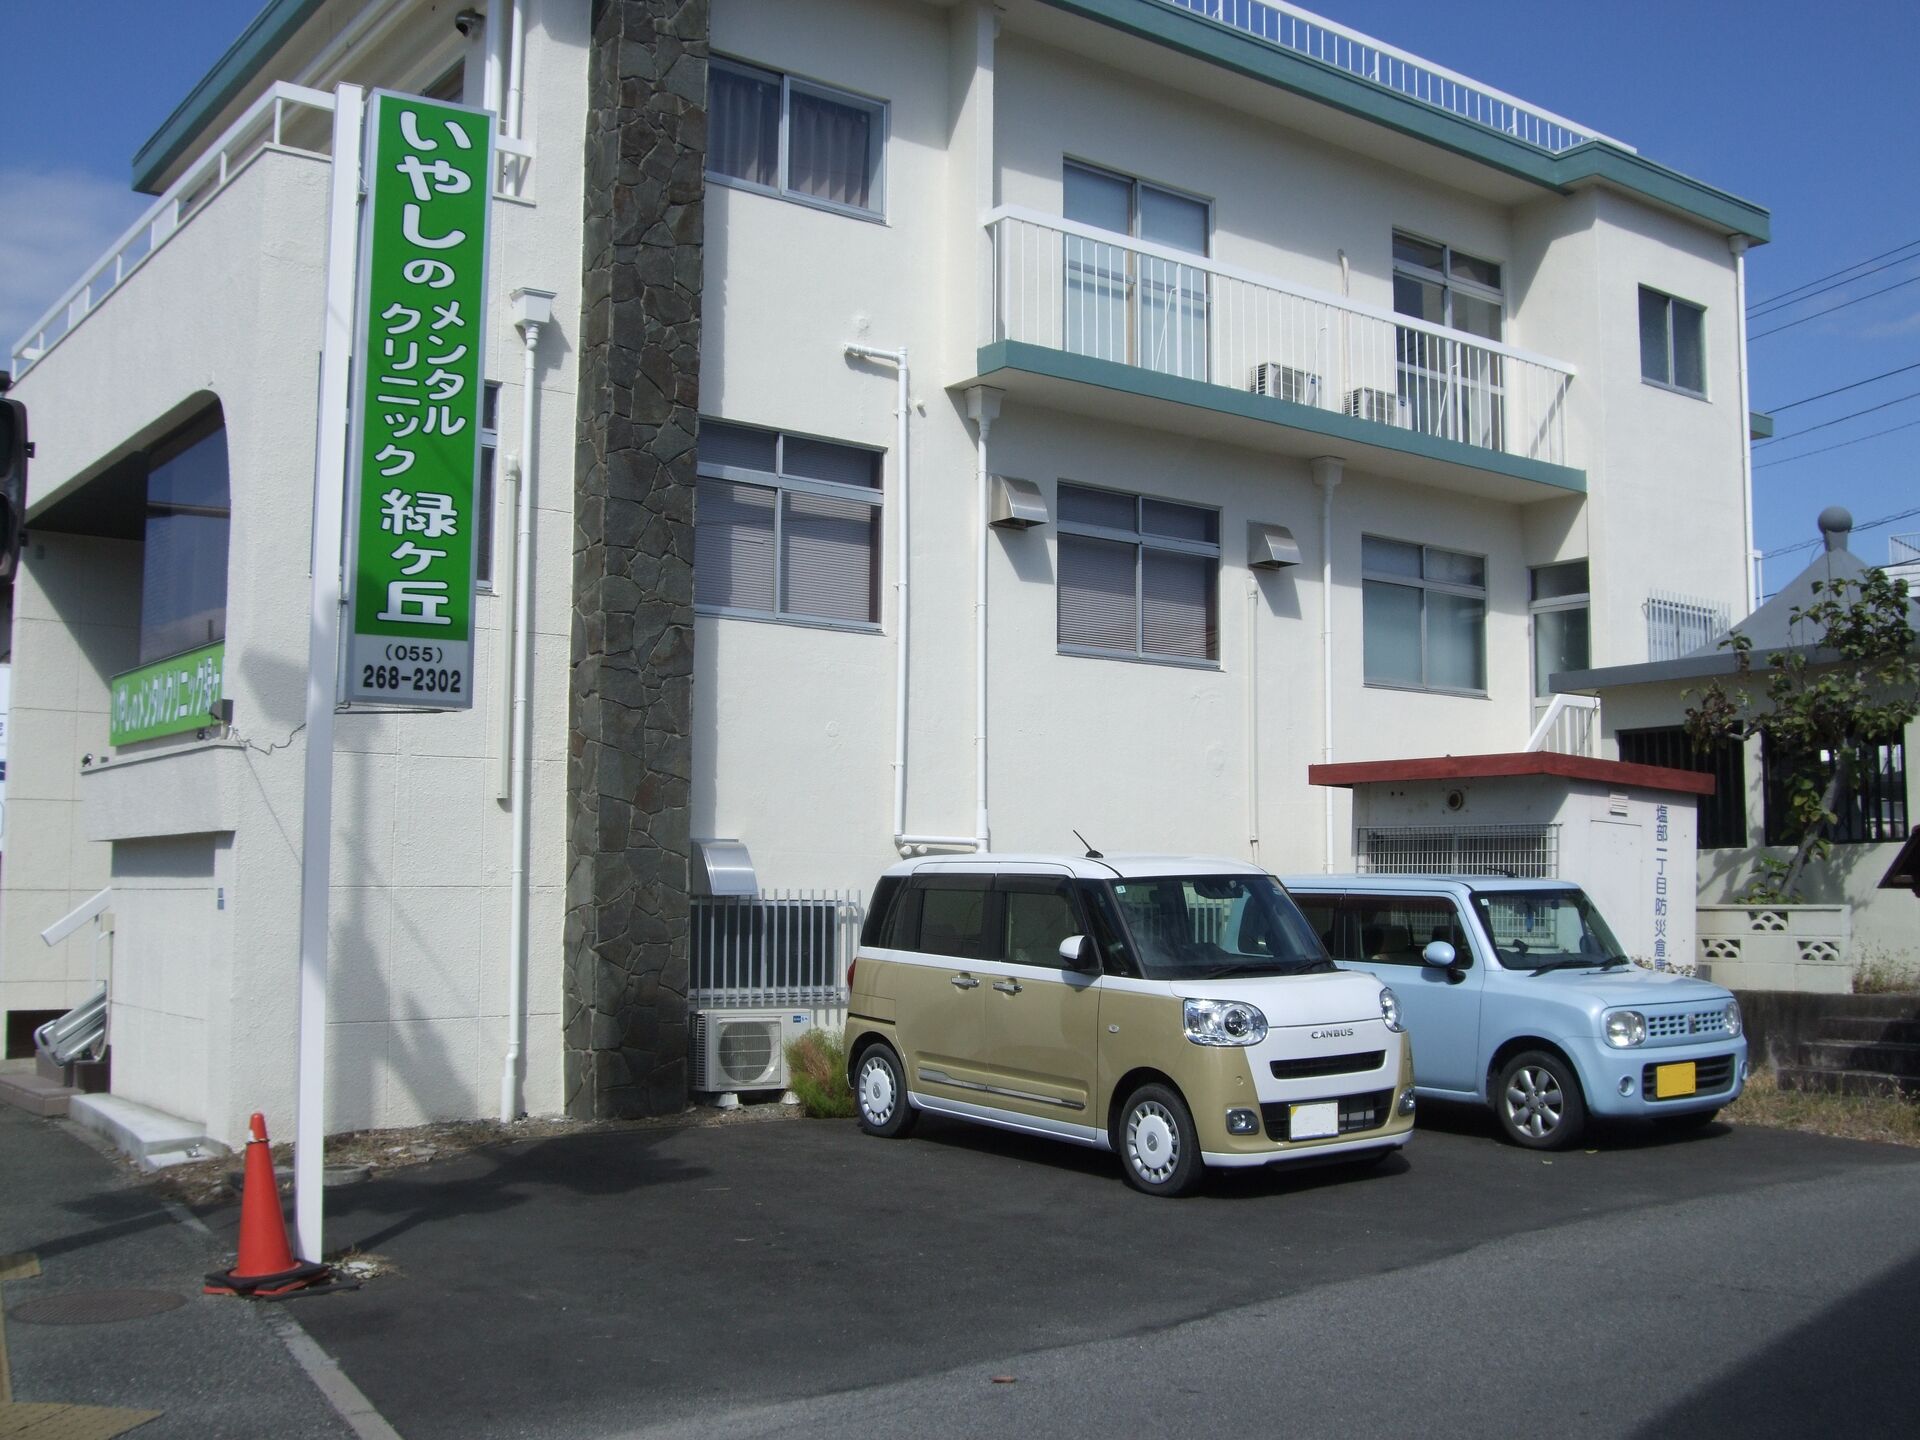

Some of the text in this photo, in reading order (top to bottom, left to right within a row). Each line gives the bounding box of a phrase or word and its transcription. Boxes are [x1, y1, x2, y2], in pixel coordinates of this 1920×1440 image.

[396, 110, 472, 289] いやしの
[374, 302, 422, 477] クリニック
[422, 300, 467, 437] メンタル
[362, 664, 462, 693] 268-2302
[385, 644, 444, 663] (055)
[1311, 1028, 1354, 1040] CANBUS
